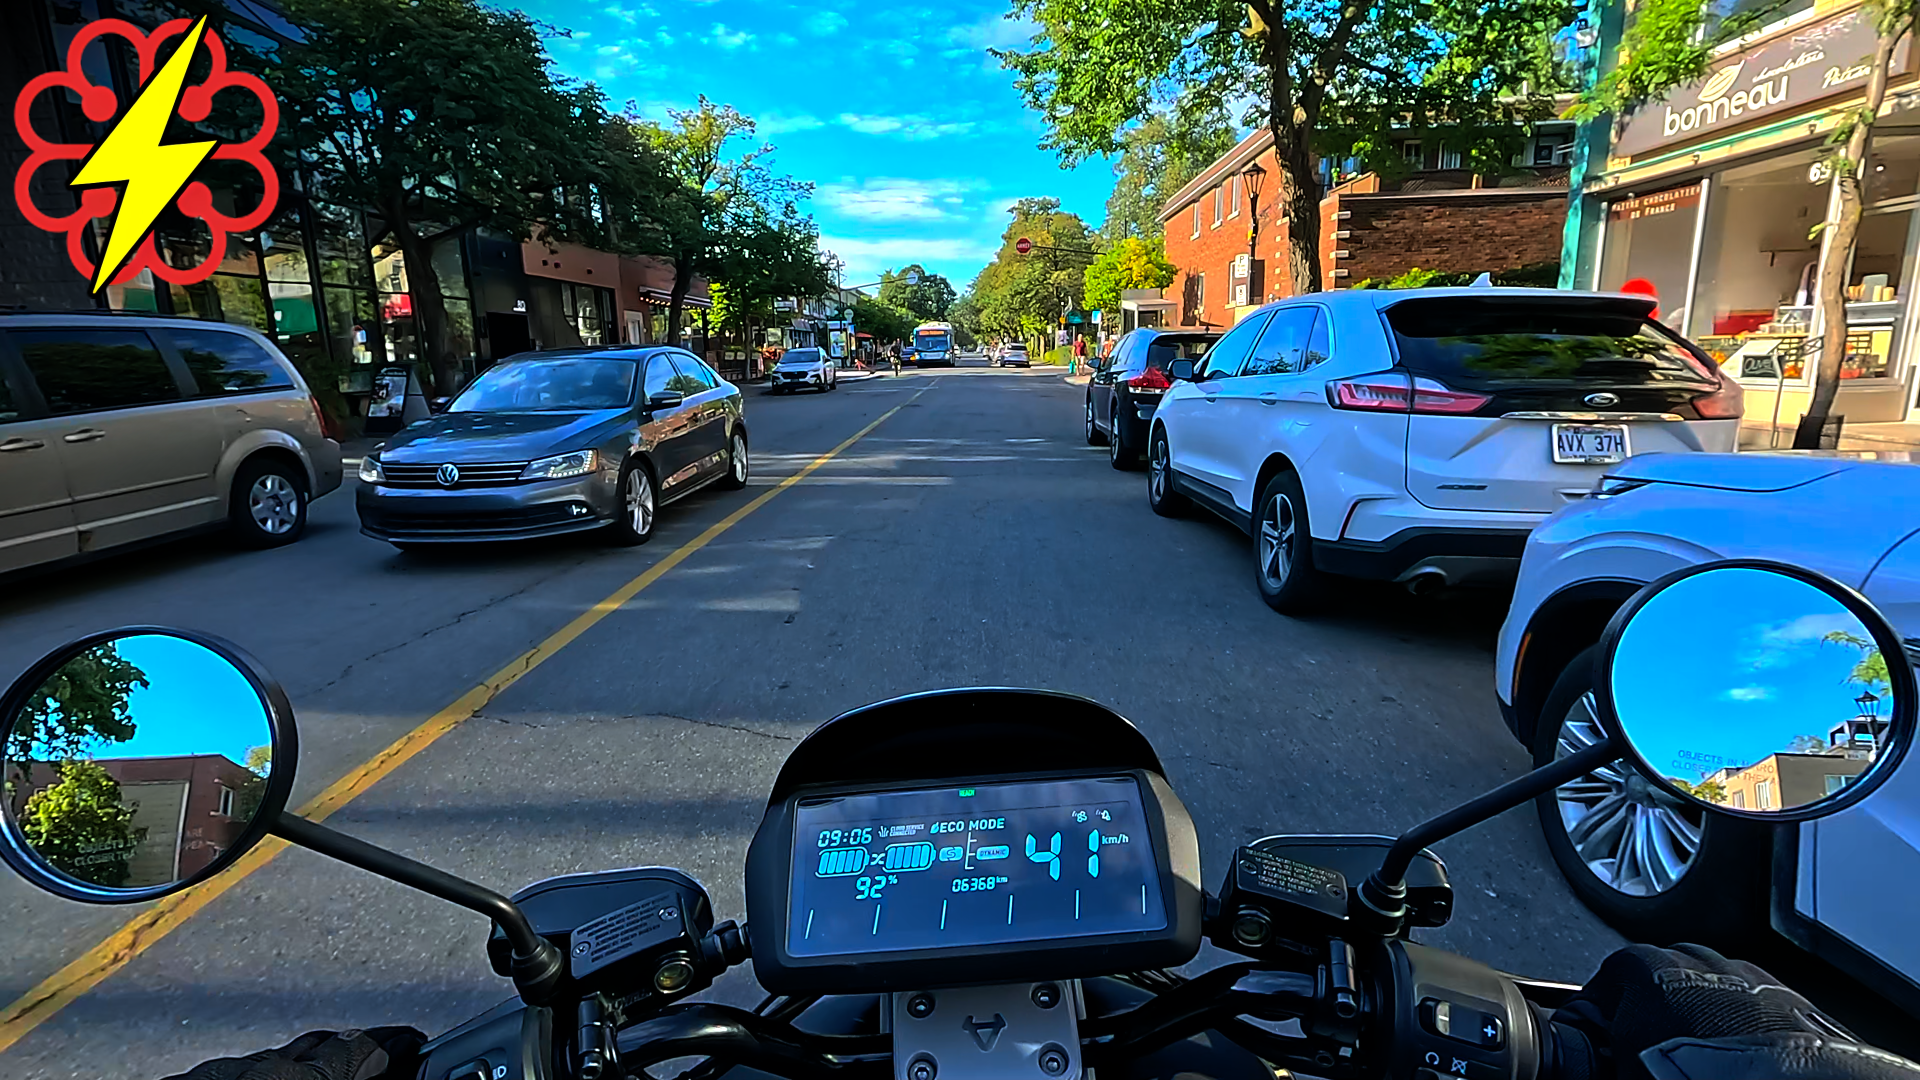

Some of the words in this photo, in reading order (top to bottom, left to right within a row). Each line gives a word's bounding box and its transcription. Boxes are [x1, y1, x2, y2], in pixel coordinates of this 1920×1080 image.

[1663, 75, 1788, 137] bonneau
[1557, 434, 1585, 452] AVX
[1594, 435, 1624, 452] 37H
[1678, 749, 1723, 765] OBJECTS
[1671, 759, 1712, 775] CLOSER
[939, 820, 965, 834] ECO
[968, 818, 1005, 831] MODE
[817, 827, 873, 848] 09:06
[74, 853, 115, 867] CLOSER
[979, 848, 1006, 857] DYNAMIC
[1025, 829, 1099, 882] 41
[1101, 833, 1129, 845] km/h
